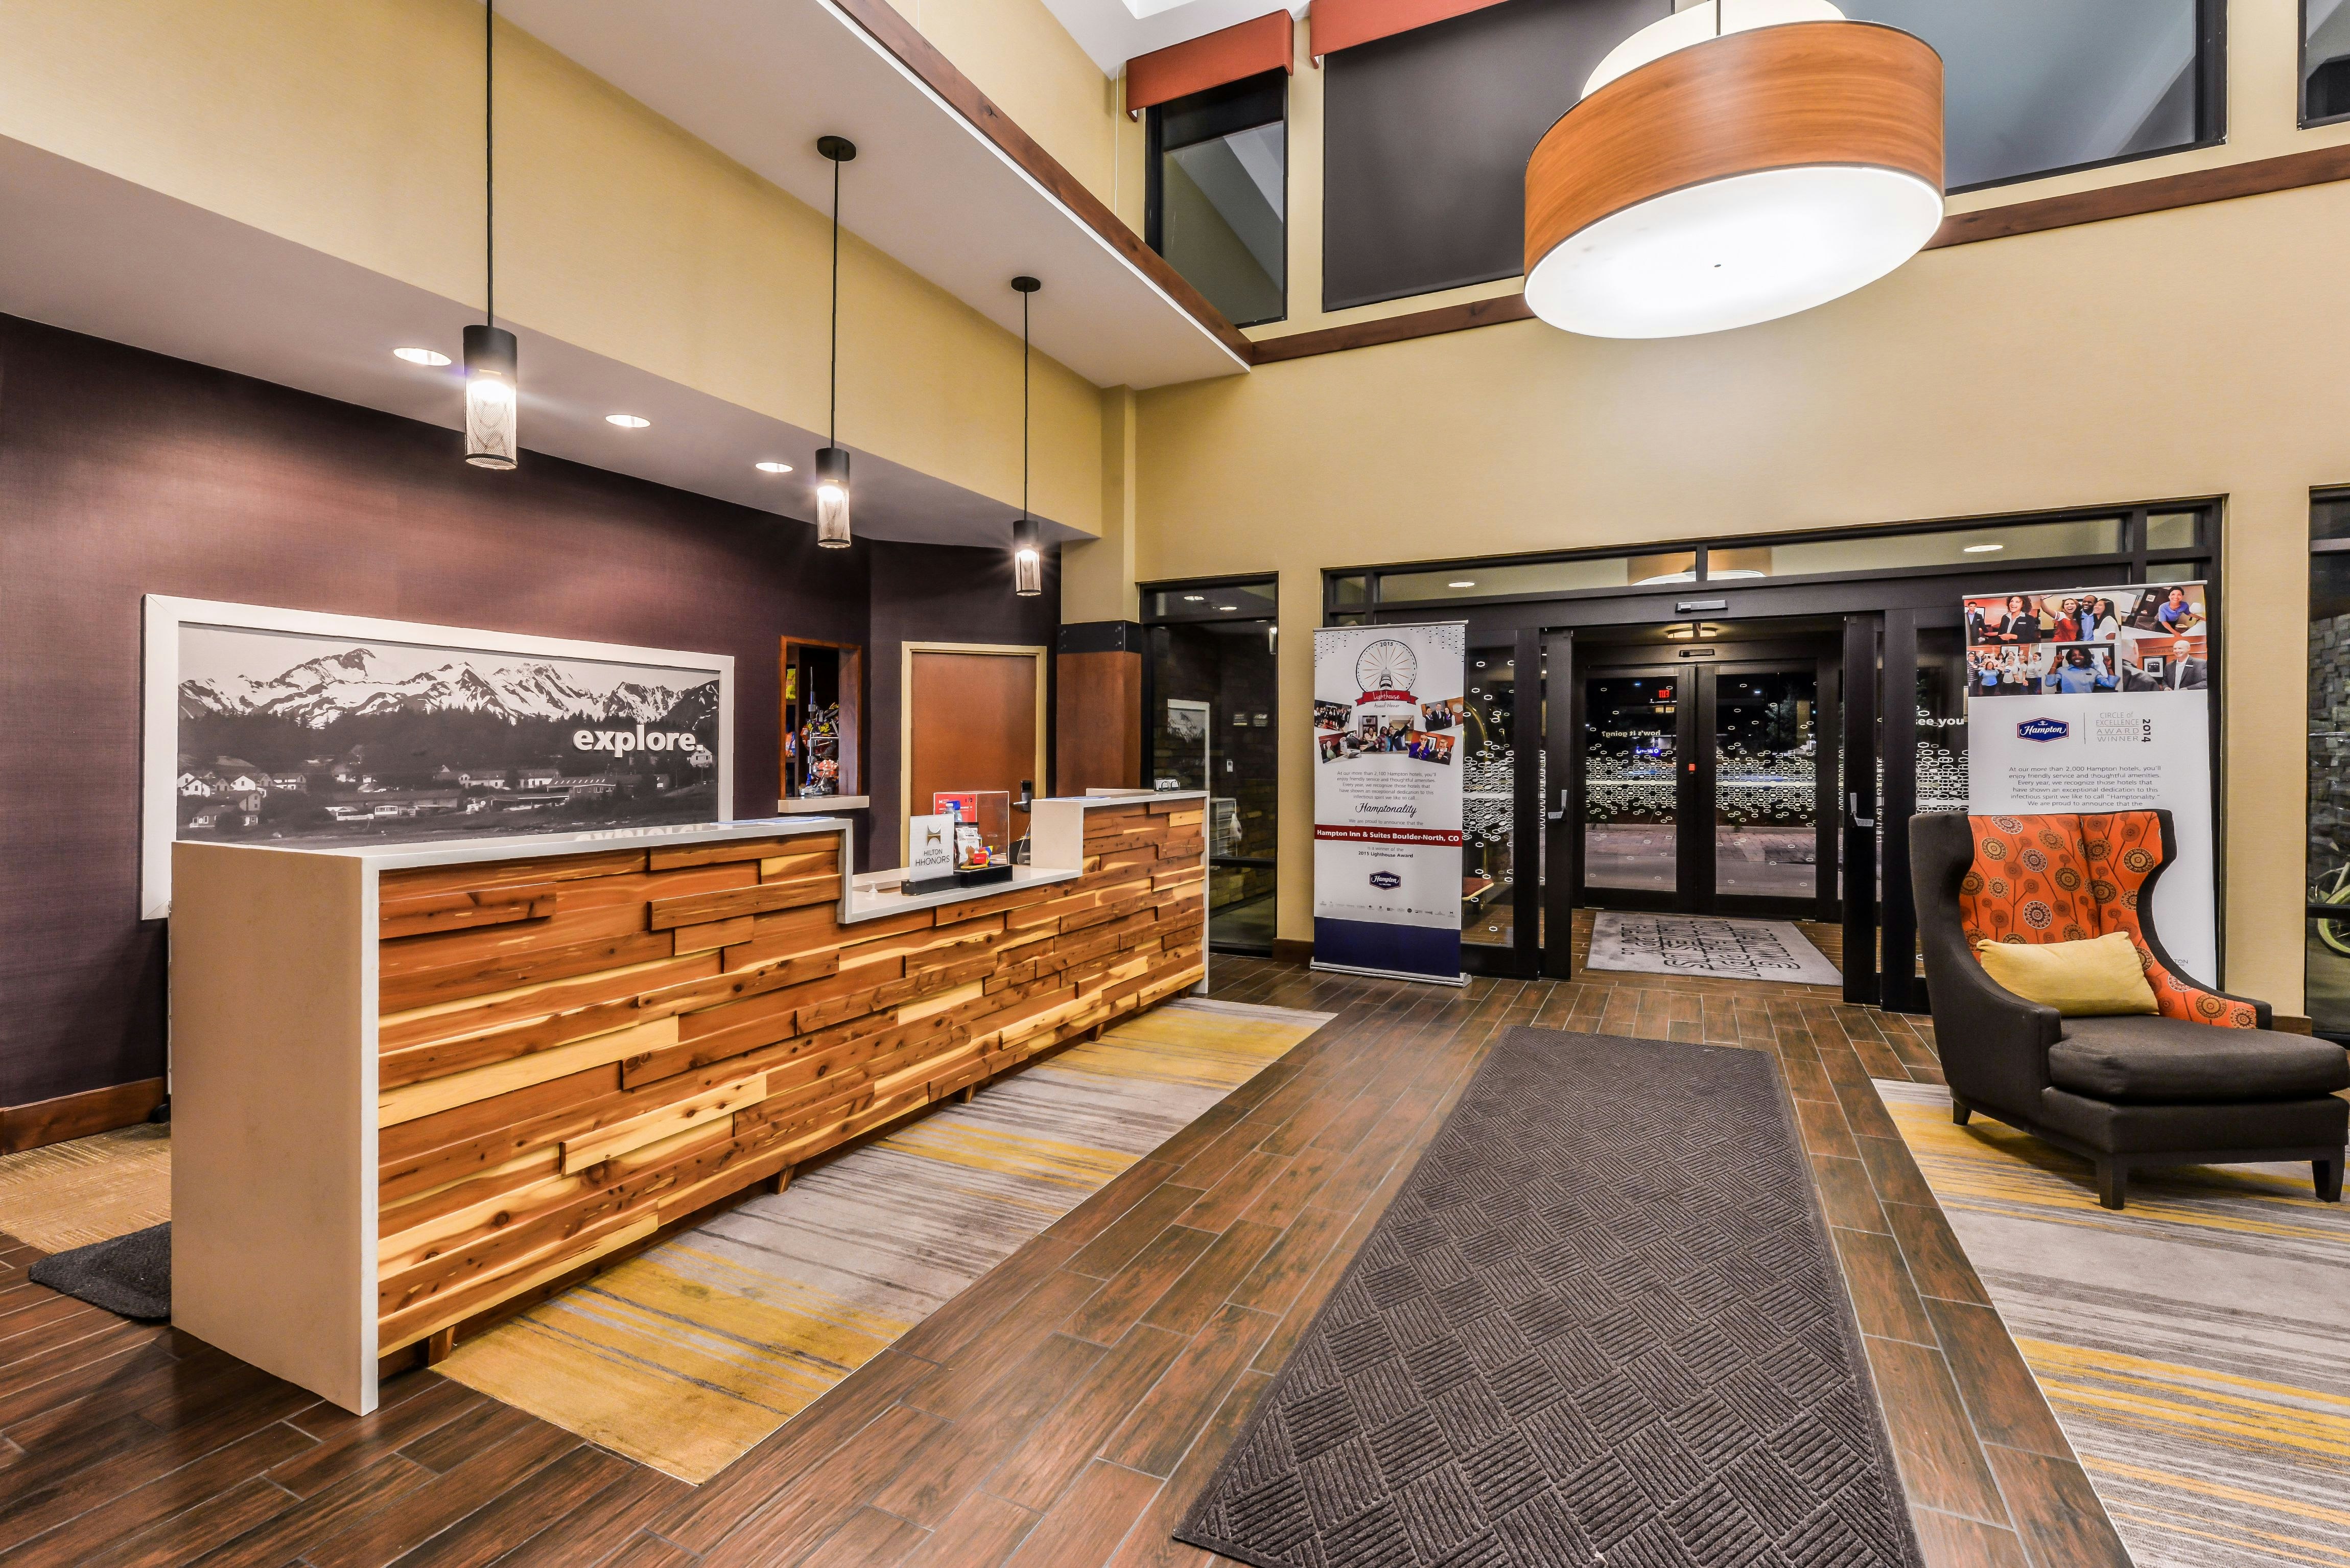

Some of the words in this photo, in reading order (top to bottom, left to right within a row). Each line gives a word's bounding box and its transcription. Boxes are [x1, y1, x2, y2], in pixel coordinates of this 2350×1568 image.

[1373, 691, 1400, 701] Lighthouse
[1938, 718, 1964, 727] you
[2019, 726, 2066, 736] Hampton
[2141, 719, 2151, 742] 2014
[573, 724, 703, 757] explore.
[1355, 802, 1417, 818] Hamptonality
[1392, 833, 1446, 841] Boulder-North,
[915, 855, 950, 867] HHONORS
[1371, 875, 1399, 884] Hampton
[1656, 919, 1707, 951] MAKES
[1691, 920, 1737, 938] YOU
[1622, 923, 1664, 956] HAPPY.
[1732, 927, 1801, 970] MAKING
[1662, 952, 1713, 970] US
[1700, 938, 1761, 977] HAPPY
